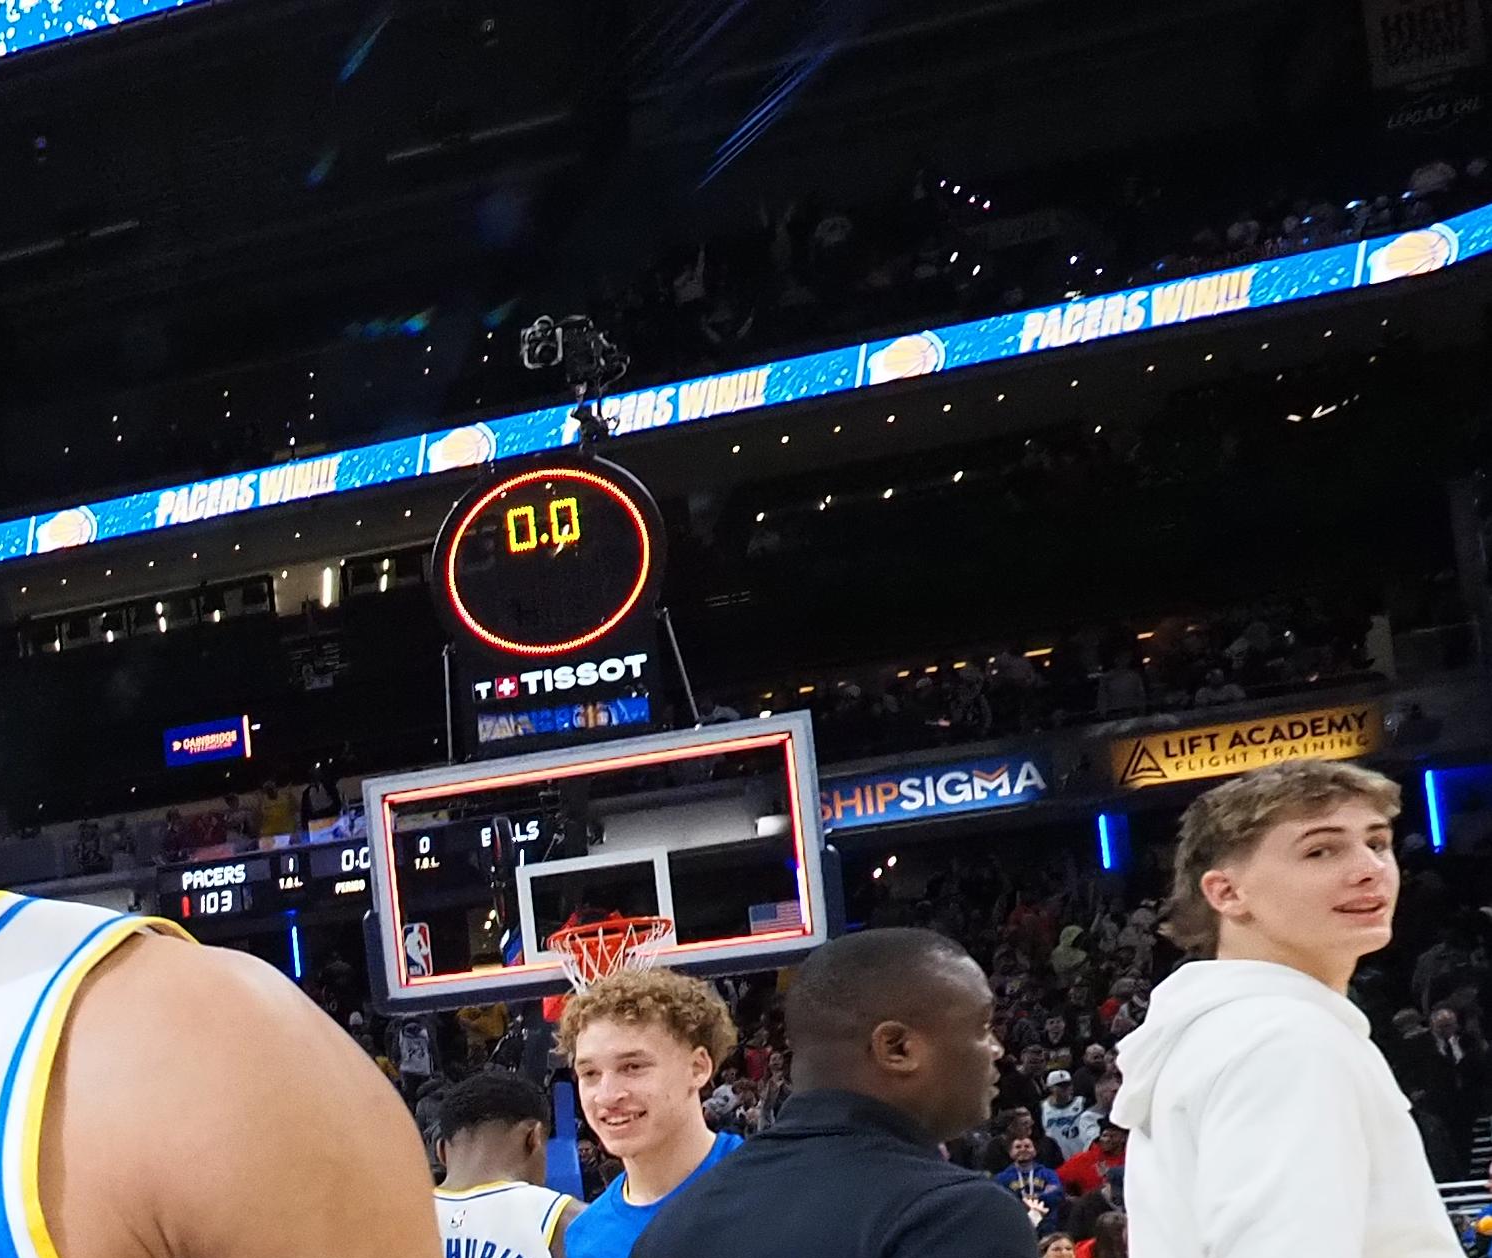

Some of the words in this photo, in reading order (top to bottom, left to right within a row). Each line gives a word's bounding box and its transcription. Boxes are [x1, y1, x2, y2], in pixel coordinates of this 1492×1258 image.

[1018, 291, 1149, 353] PACERS
[1152, 268, 1256, 326] WIN!!!
[678, 365, 772, 421] WIN!!!
[156, 474, 258, 527] PACERS
[259, 455, 342, 506] WIN!!!
[507, 497, 581, 553] 0.0
[520, 654, 648, 694] TISSOT
[1165, 733, 1220, 759] LIFT
[1228, 710, 1368, 750] ACADEMY
[1175, 751, 1249, 772] FLIGHT
[1262, 735, 1370, 761] TRAINING
[182, 864, 246, 890] PACERS
[200, 890, 232, 914] 103
